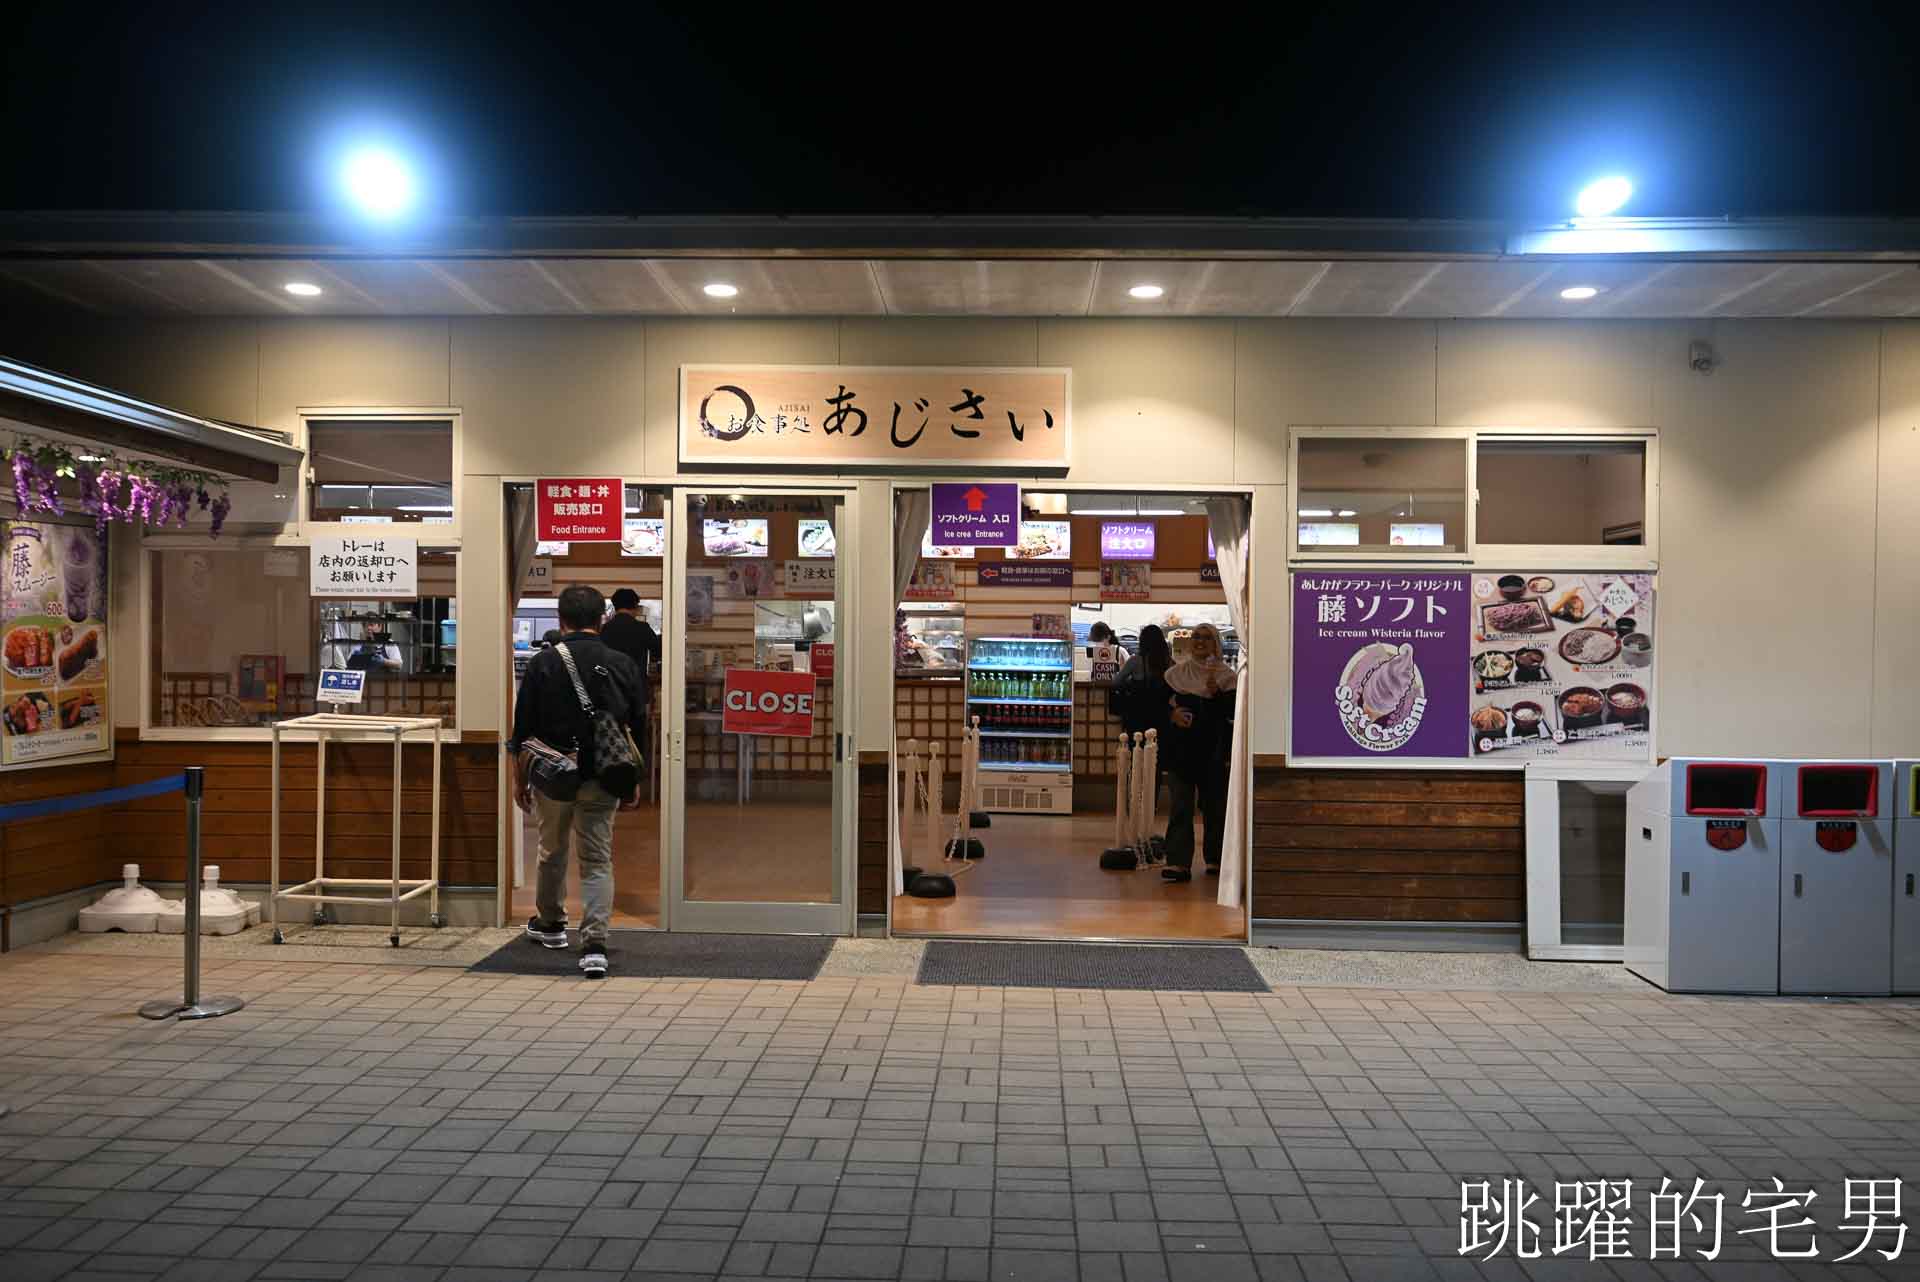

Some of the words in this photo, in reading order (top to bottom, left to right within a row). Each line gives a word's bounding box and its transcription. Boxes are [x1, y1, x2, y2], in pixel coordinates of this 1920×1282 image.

[823, 384, 1054, 448] あじさい
[727, 413, 811, 435] お食事処
[554, 503, 603, 515] 販売窓口
[937, 514, 986, 523] ソフトクリーム
[992, 514, 1010, 523] 入口
[551, 525, 571, 534] Food
[572, 525, 606, 534] Entrance
[944, 530, 954, 538] Ice
[975, 530, 1004, 538] Entrance
[1103, 525, 1153, 535] ソフトクリーム
[343, 540, 385, 552] トレーは
[11, 542, 32, 578] 藤
[319, 554, 409, 568] 店内の返却口へ
[330, 570, 397, 583] お願いします
[1413, 579, 1464, 591] オリジナル
[1317, 594, 1448, 624] 藤ソフト
[1319, 628, 1334, 638] Ice
[1337, 629, 1368, 638] cream
[1371, 628, 1412, 638] Wisteria
[1415, 628, 1446, 638] flavor
[1095, 663, 1115, 672] CASH
[726, 690, 813, 714] CLOSE
[1335, 686, 1370, 728] Soft
[1365, 697, 1427, 742] Cream
